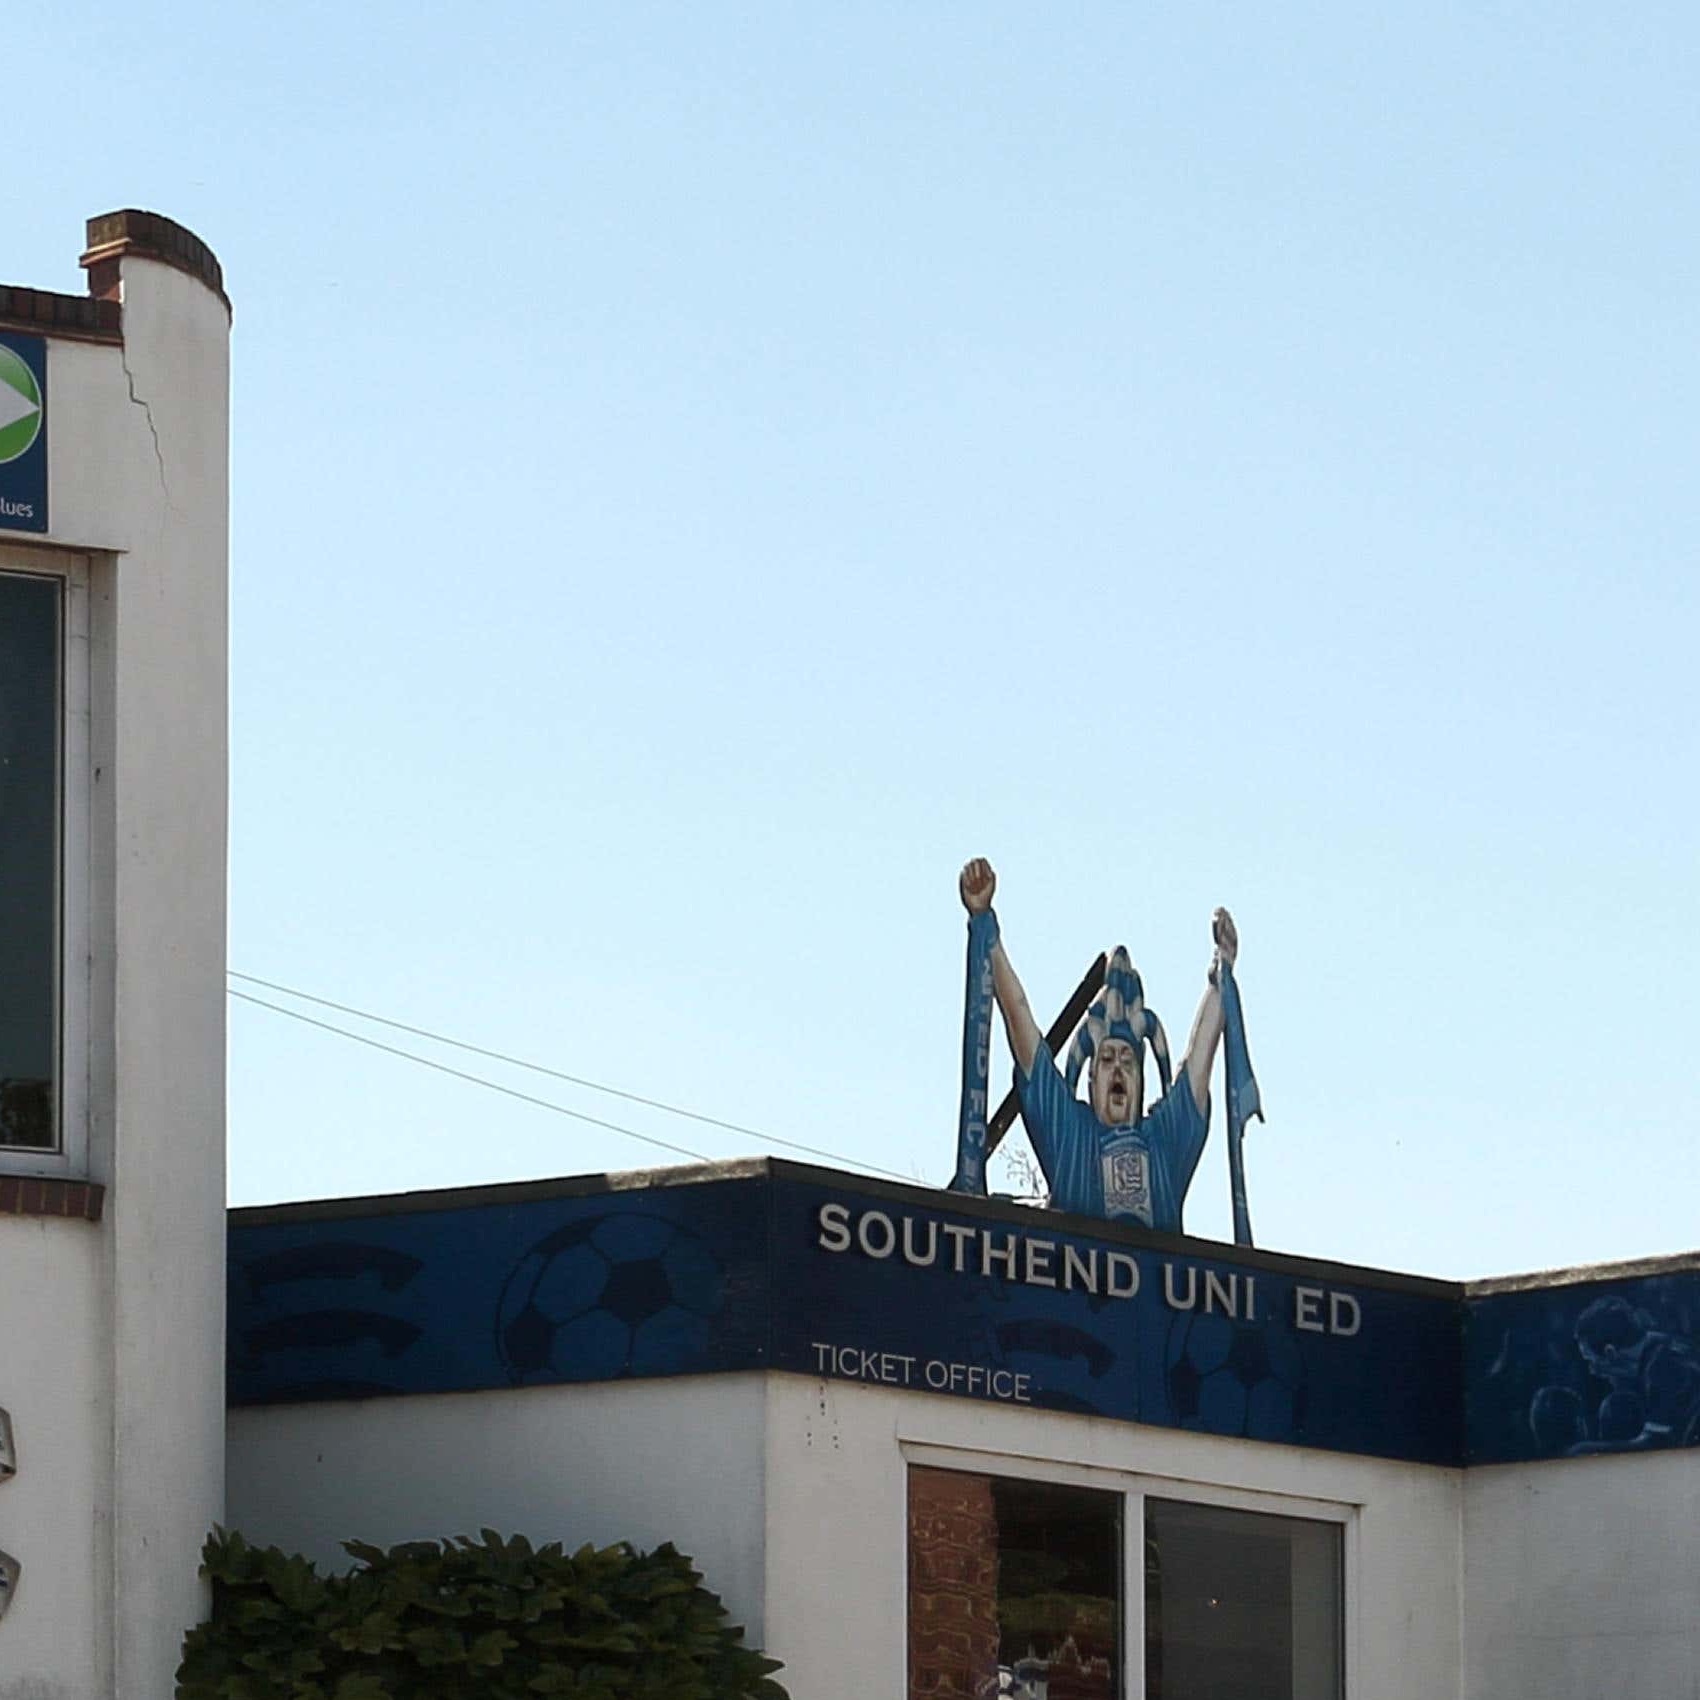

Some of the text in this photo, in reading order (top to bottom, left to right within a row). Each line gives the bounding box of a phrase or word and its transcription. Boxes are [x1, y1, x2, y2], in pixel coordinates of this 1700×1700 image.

[818, 1203, 1141, 1299] SOUTHEND
[811, 1342, 1032, 1402] TICKET OFFICE
